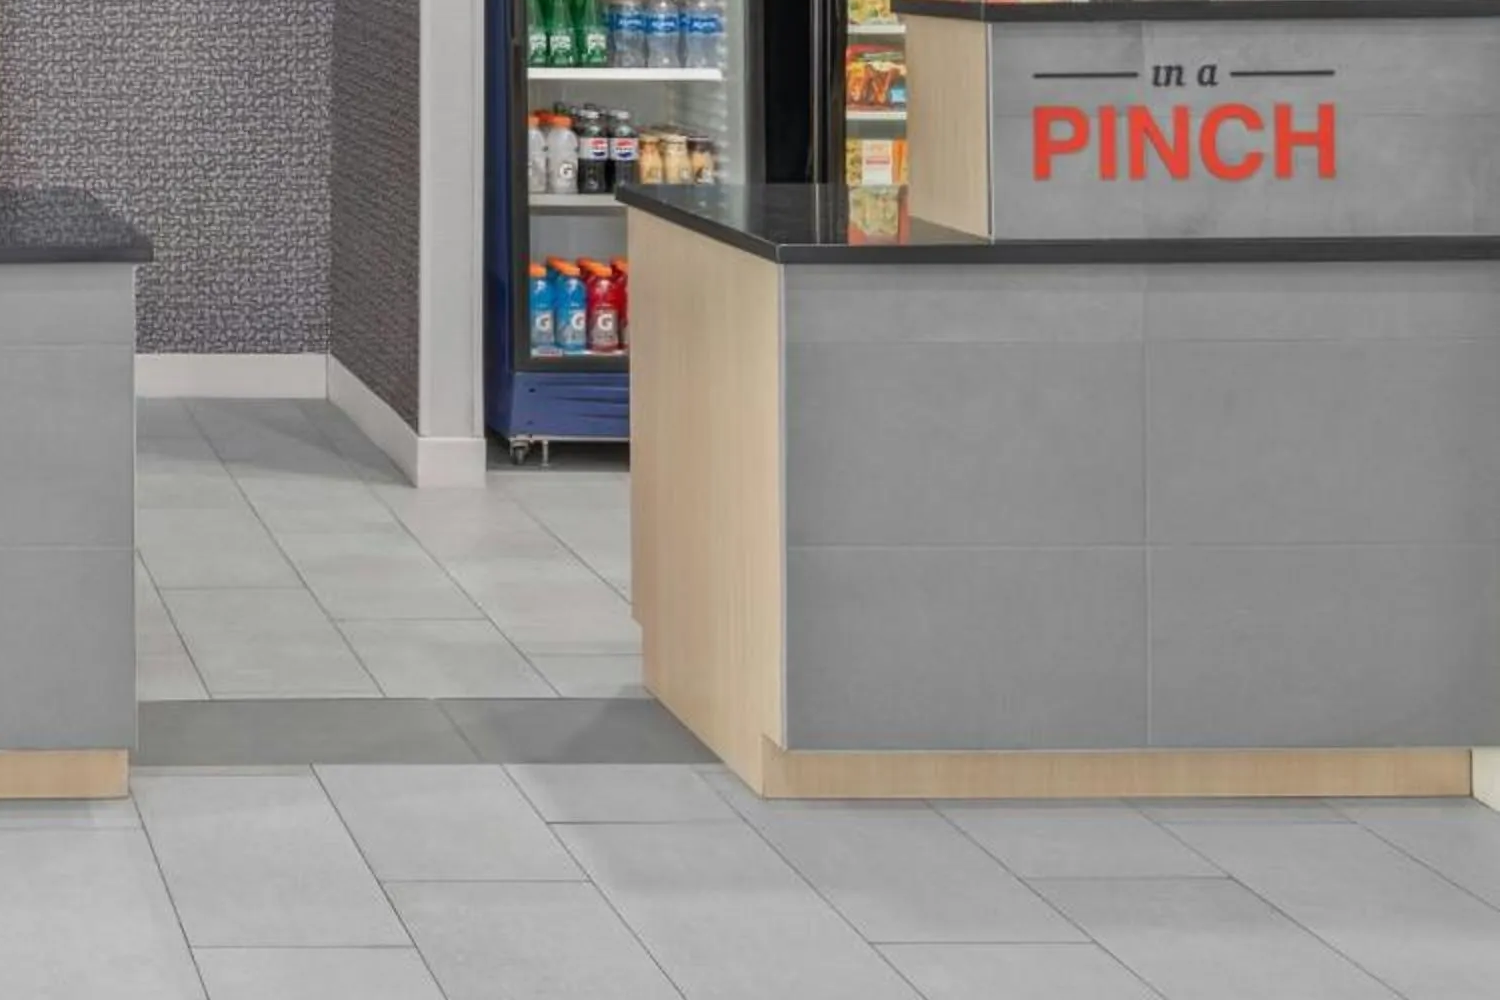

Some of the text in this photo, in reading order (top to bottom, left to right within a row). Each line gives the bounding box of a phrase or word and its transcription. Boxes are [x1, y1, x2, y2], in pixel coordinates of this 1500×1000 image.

[1152, 63, 1219, 88] in a
[1031, 103, 1337, 182] PINCH
[597, 313, 613, 331] G
